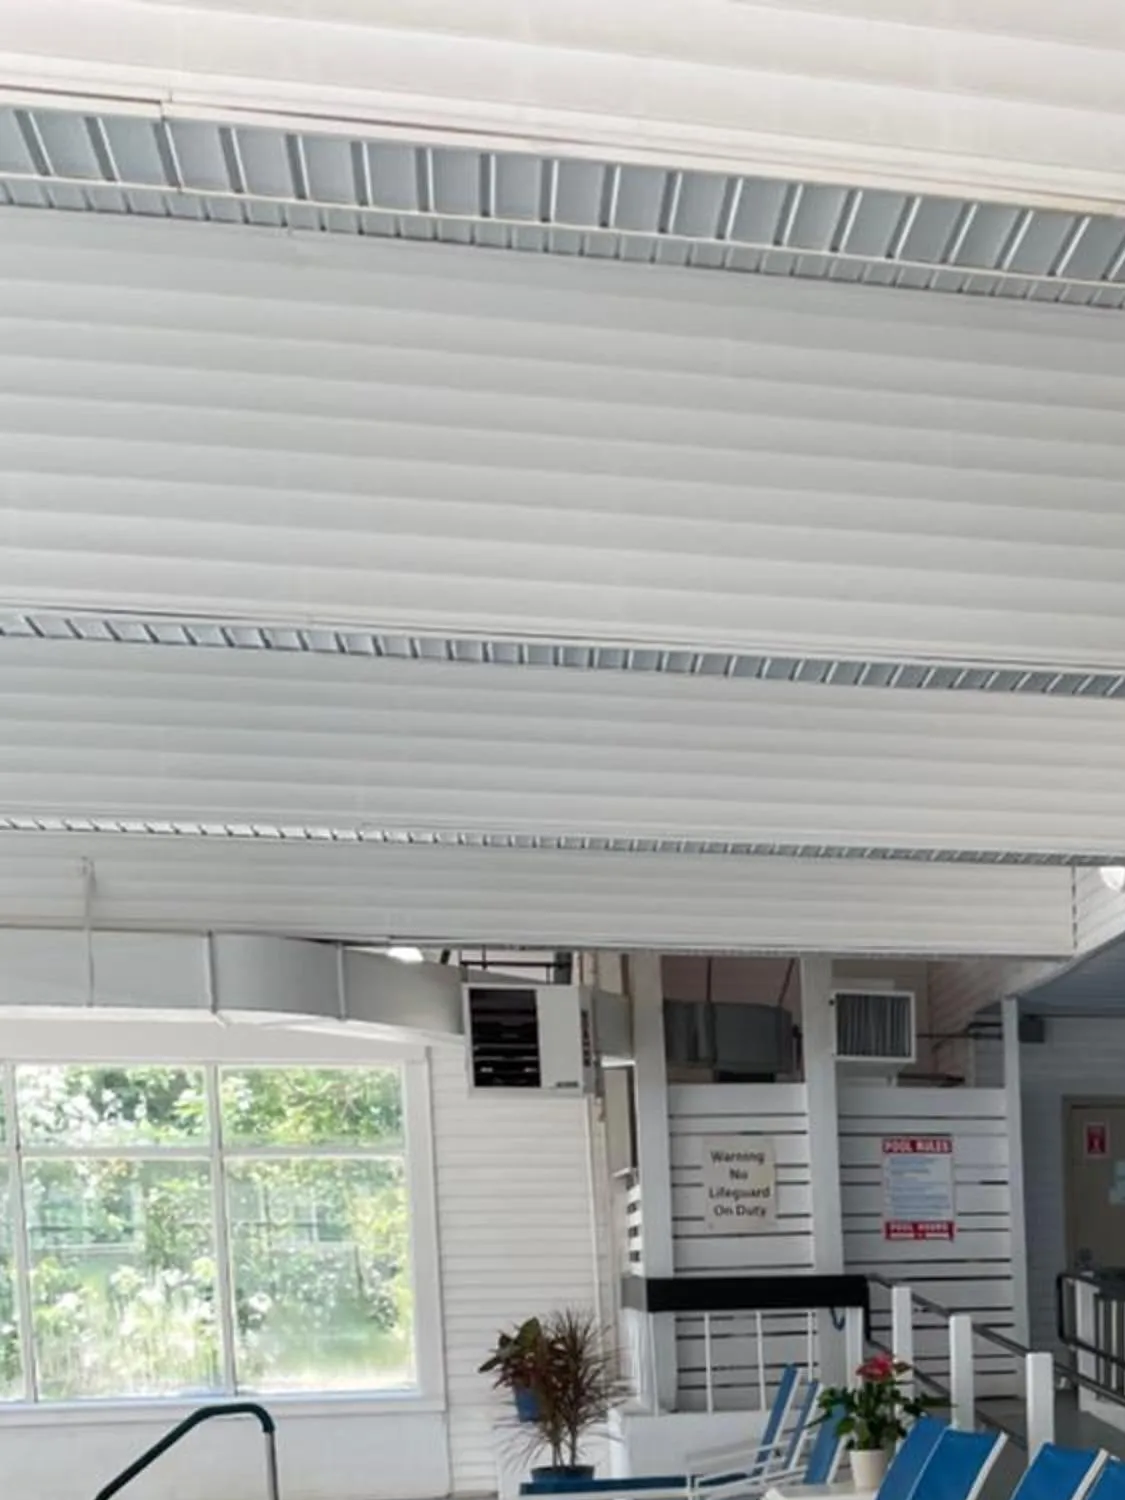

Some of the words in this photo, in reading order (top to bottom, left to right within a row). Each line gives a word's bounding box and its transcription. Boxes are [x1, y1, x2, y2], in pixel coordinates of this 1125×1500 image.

[884, 1140, 912, 1152] POOL
[916, 1140, 949, 1152] RULES
[710, 1150, 765, 1166] Warning
[729, 1168, 748, 1180] No
[709, 1186, 771, 1201] Lifeguard
[713, 1204, 734, 1216] On
[735, 1204, 766, 1218] Duty
